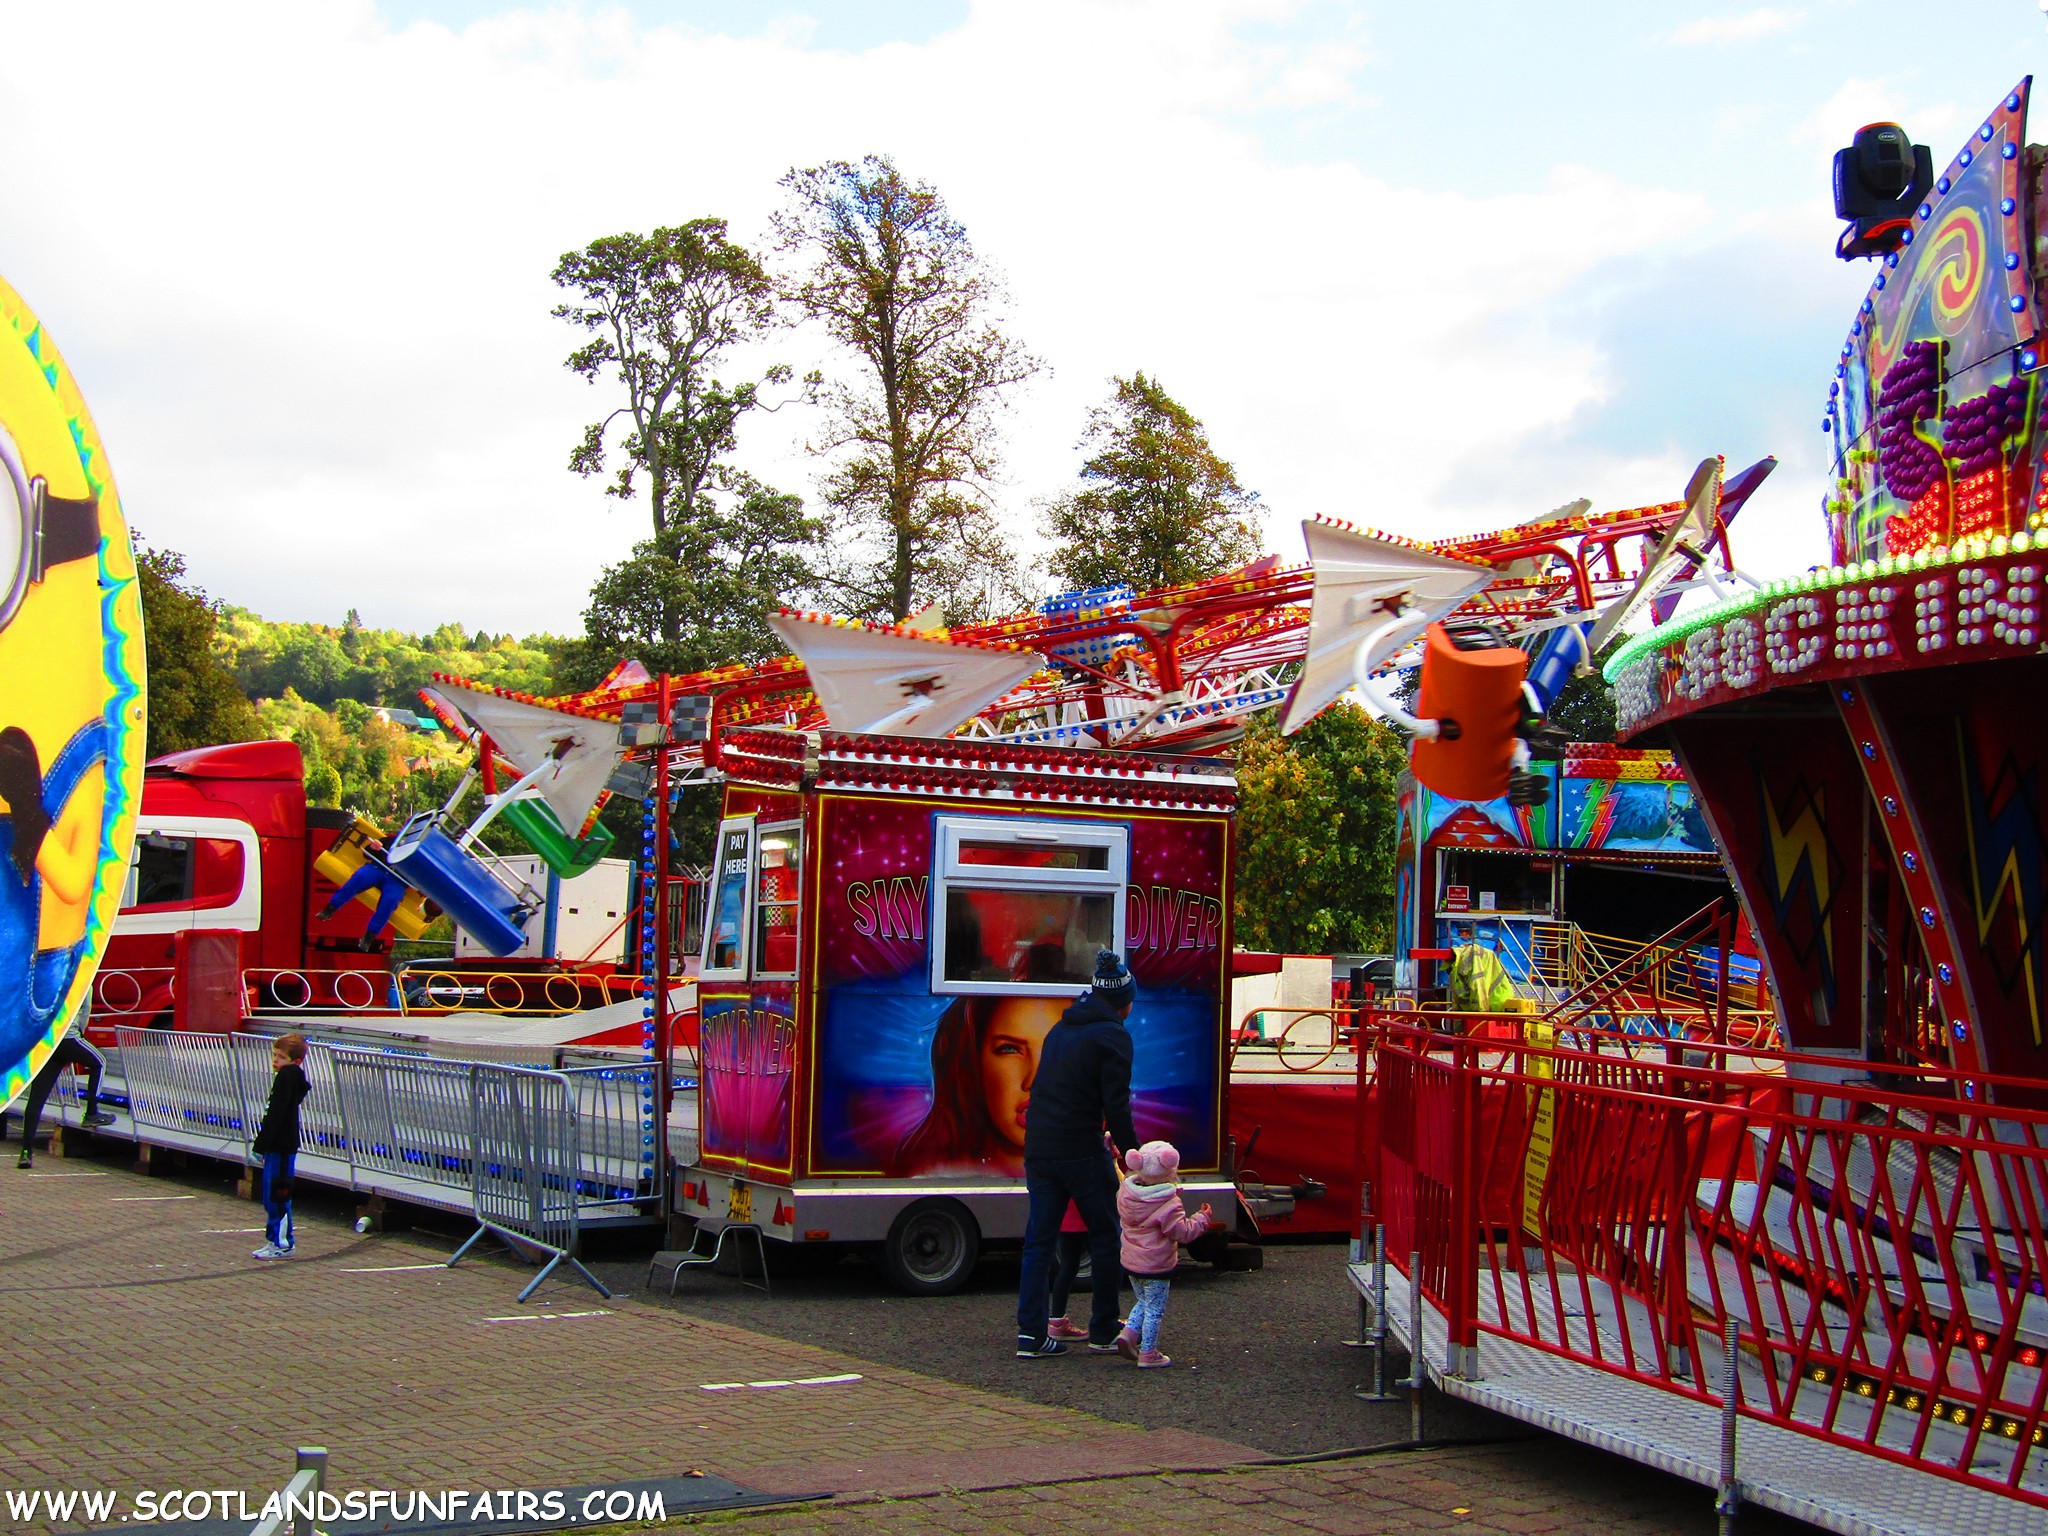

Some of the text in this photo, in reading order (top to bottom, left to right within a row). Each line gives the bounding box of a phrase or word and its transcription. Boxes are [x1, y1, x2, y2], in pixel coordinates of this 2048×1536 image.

[731, 834, 746, 850] PAY
[725, 858, 747, 875] HERE
[847, 876, 1223, 949] SKY DIVER
[702, 1008, 797, 1076] SKY DIVER
